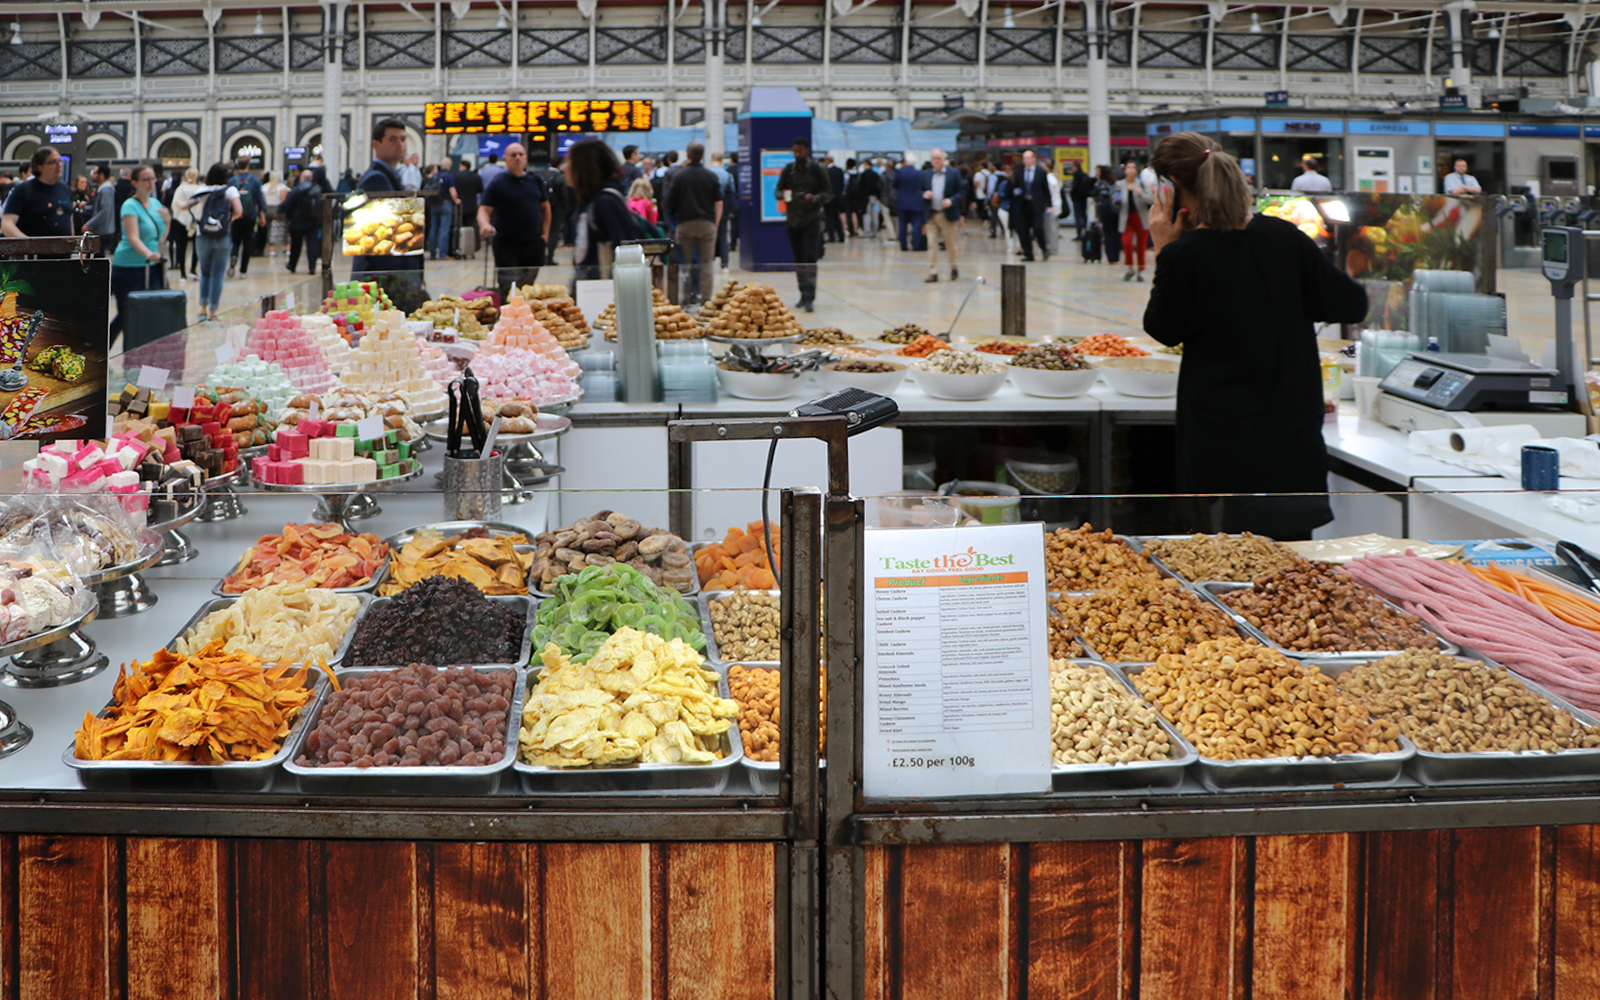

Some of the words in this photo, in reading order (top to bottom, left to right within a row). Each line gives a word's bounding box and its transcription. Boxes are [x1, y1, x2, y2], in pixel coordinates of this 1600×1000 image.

[879, 557, 931, 570] Taste
[934, 552, 974, 568] the
[976, 553, 1015, 566] Best
[888, 578, 925, 586] Product
[959, 574, 1004, 583] Ingredients
[893, 757, 923, 767] £2.50
[927, 758, 945, 768] per
[950, 756, 975, 767] 100g
